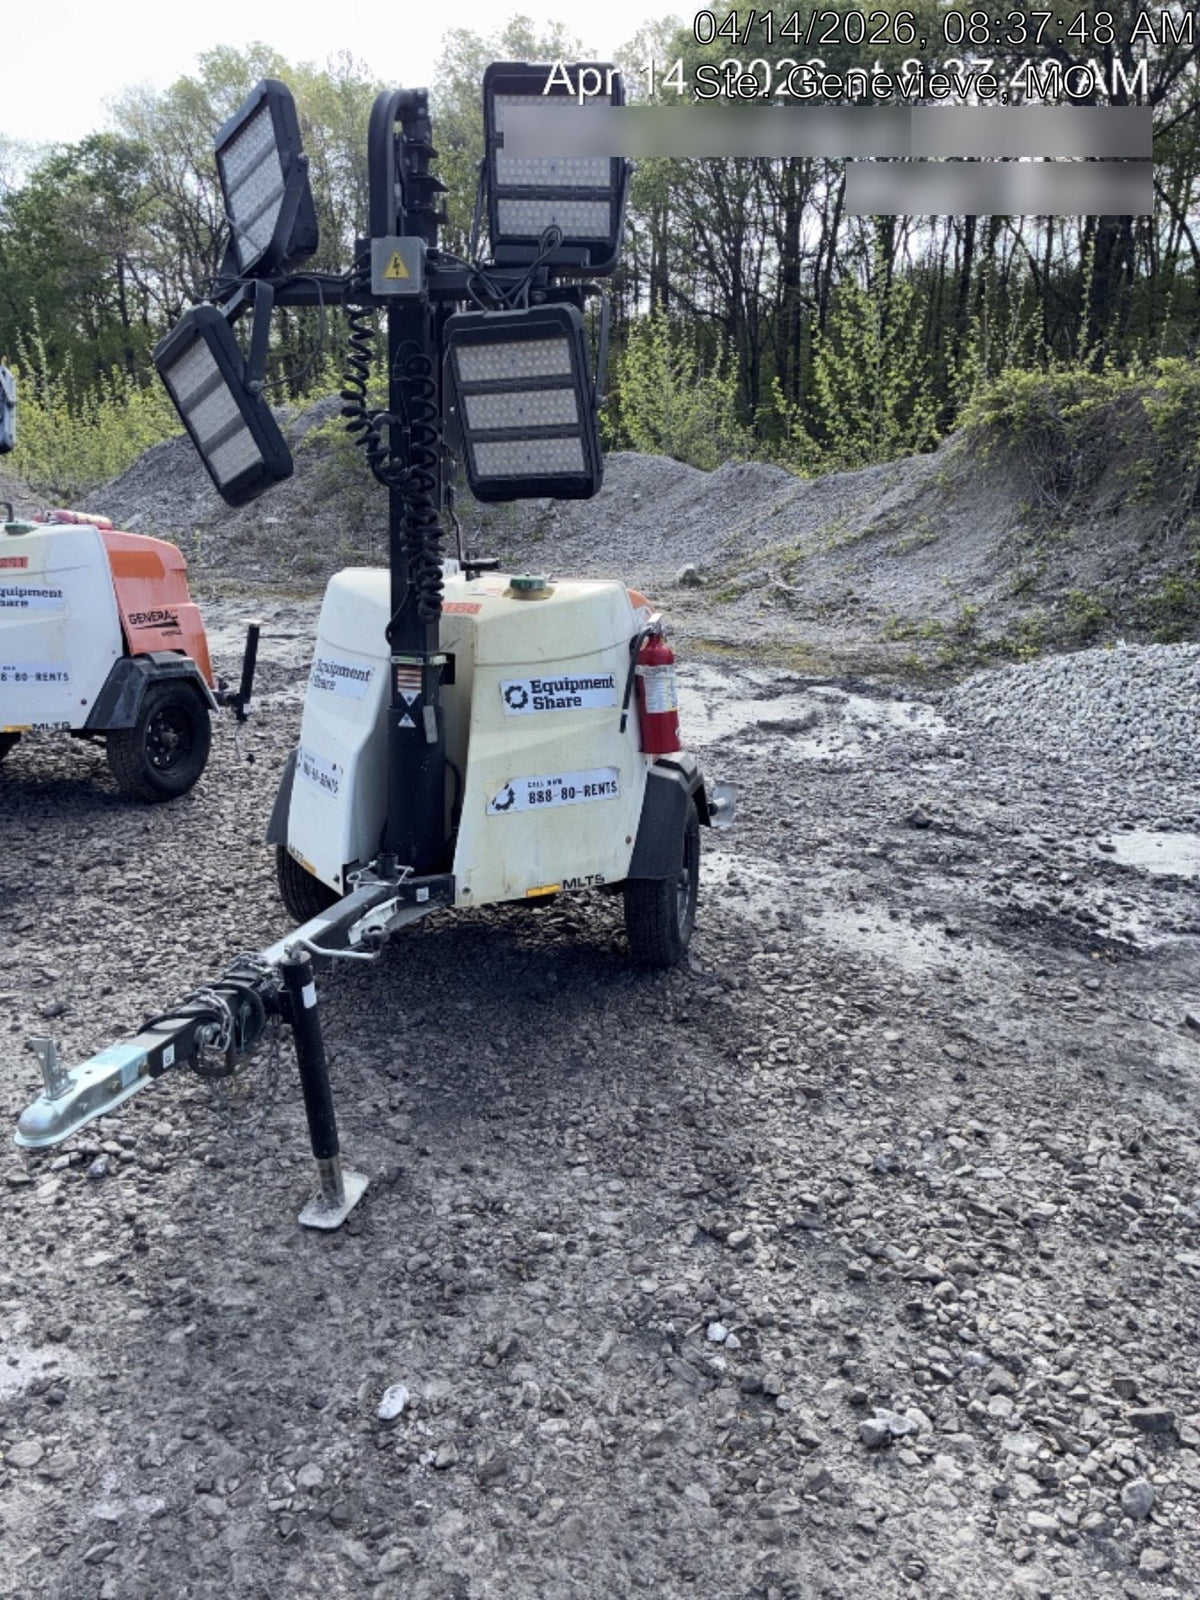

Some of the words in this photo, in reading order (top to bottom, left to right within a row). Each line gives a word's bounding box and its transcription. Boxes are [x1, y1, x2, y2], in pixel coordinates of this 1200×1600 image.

[529, 675, 615, 696] Equipment
[533, 695, 582, 710] Share
[528, 780, 618, 804] 888-80-RENTS
